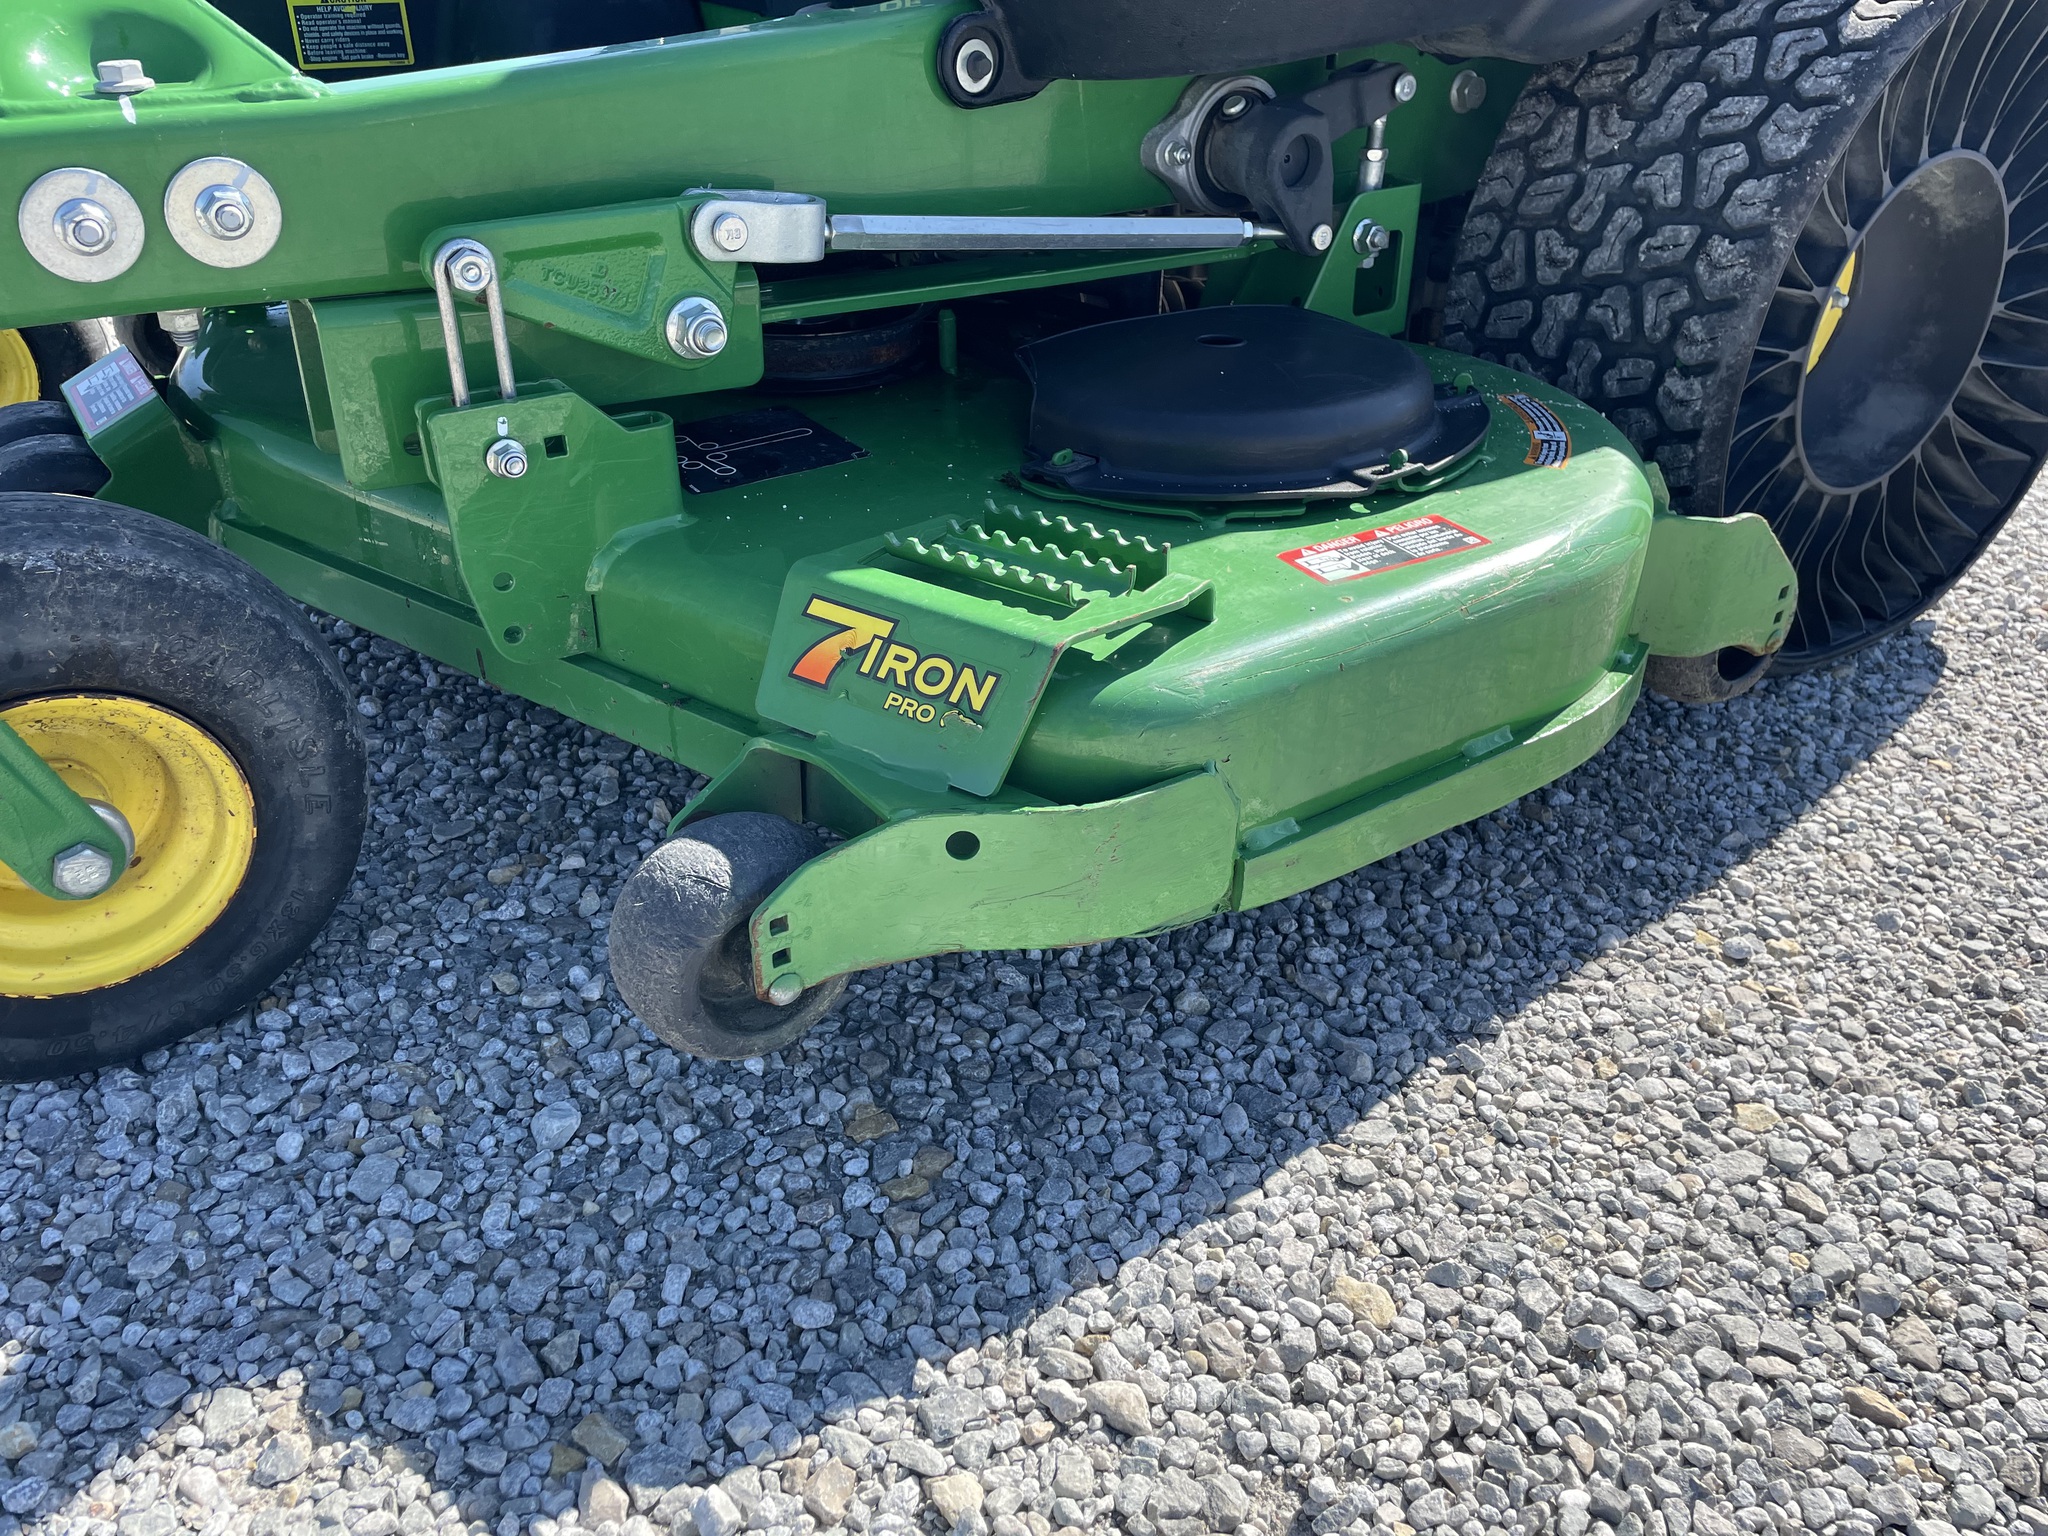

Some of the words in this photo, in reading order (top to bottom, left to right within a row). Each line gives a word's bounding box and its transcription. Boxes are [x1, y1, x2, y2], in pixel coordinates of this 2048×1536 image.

[320, 37, 335, 45] carry
[1385, 517, 1434, 534] PELIGRO
[1312, 535, 1362, 552] DANGER
[788, 593, 900, 690] 7
[857, 633, 1002, 716] IRON
[883, 690, 936, 723] PRO
